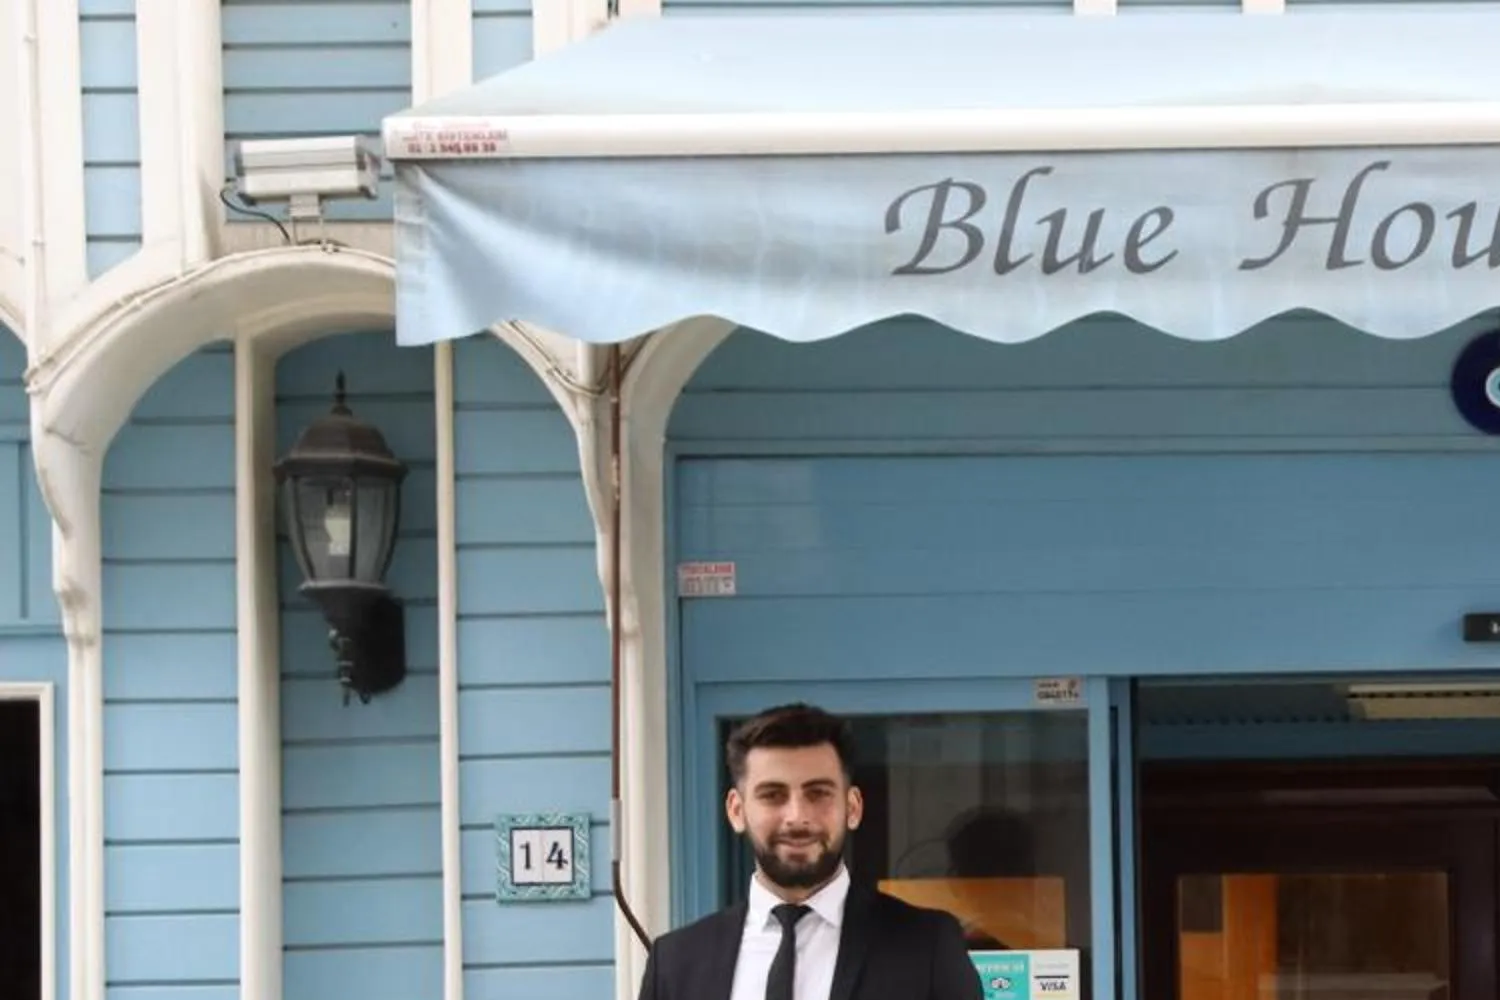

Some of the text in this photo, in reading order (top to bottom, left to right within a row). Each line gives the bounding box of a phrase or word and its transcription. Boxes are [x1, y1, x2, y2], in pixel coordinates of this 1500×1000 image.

[884, 165, 1178, 277] Blue
[518, 841, 569, 870] 14
[1040, 981, 1067, 991] VISA
